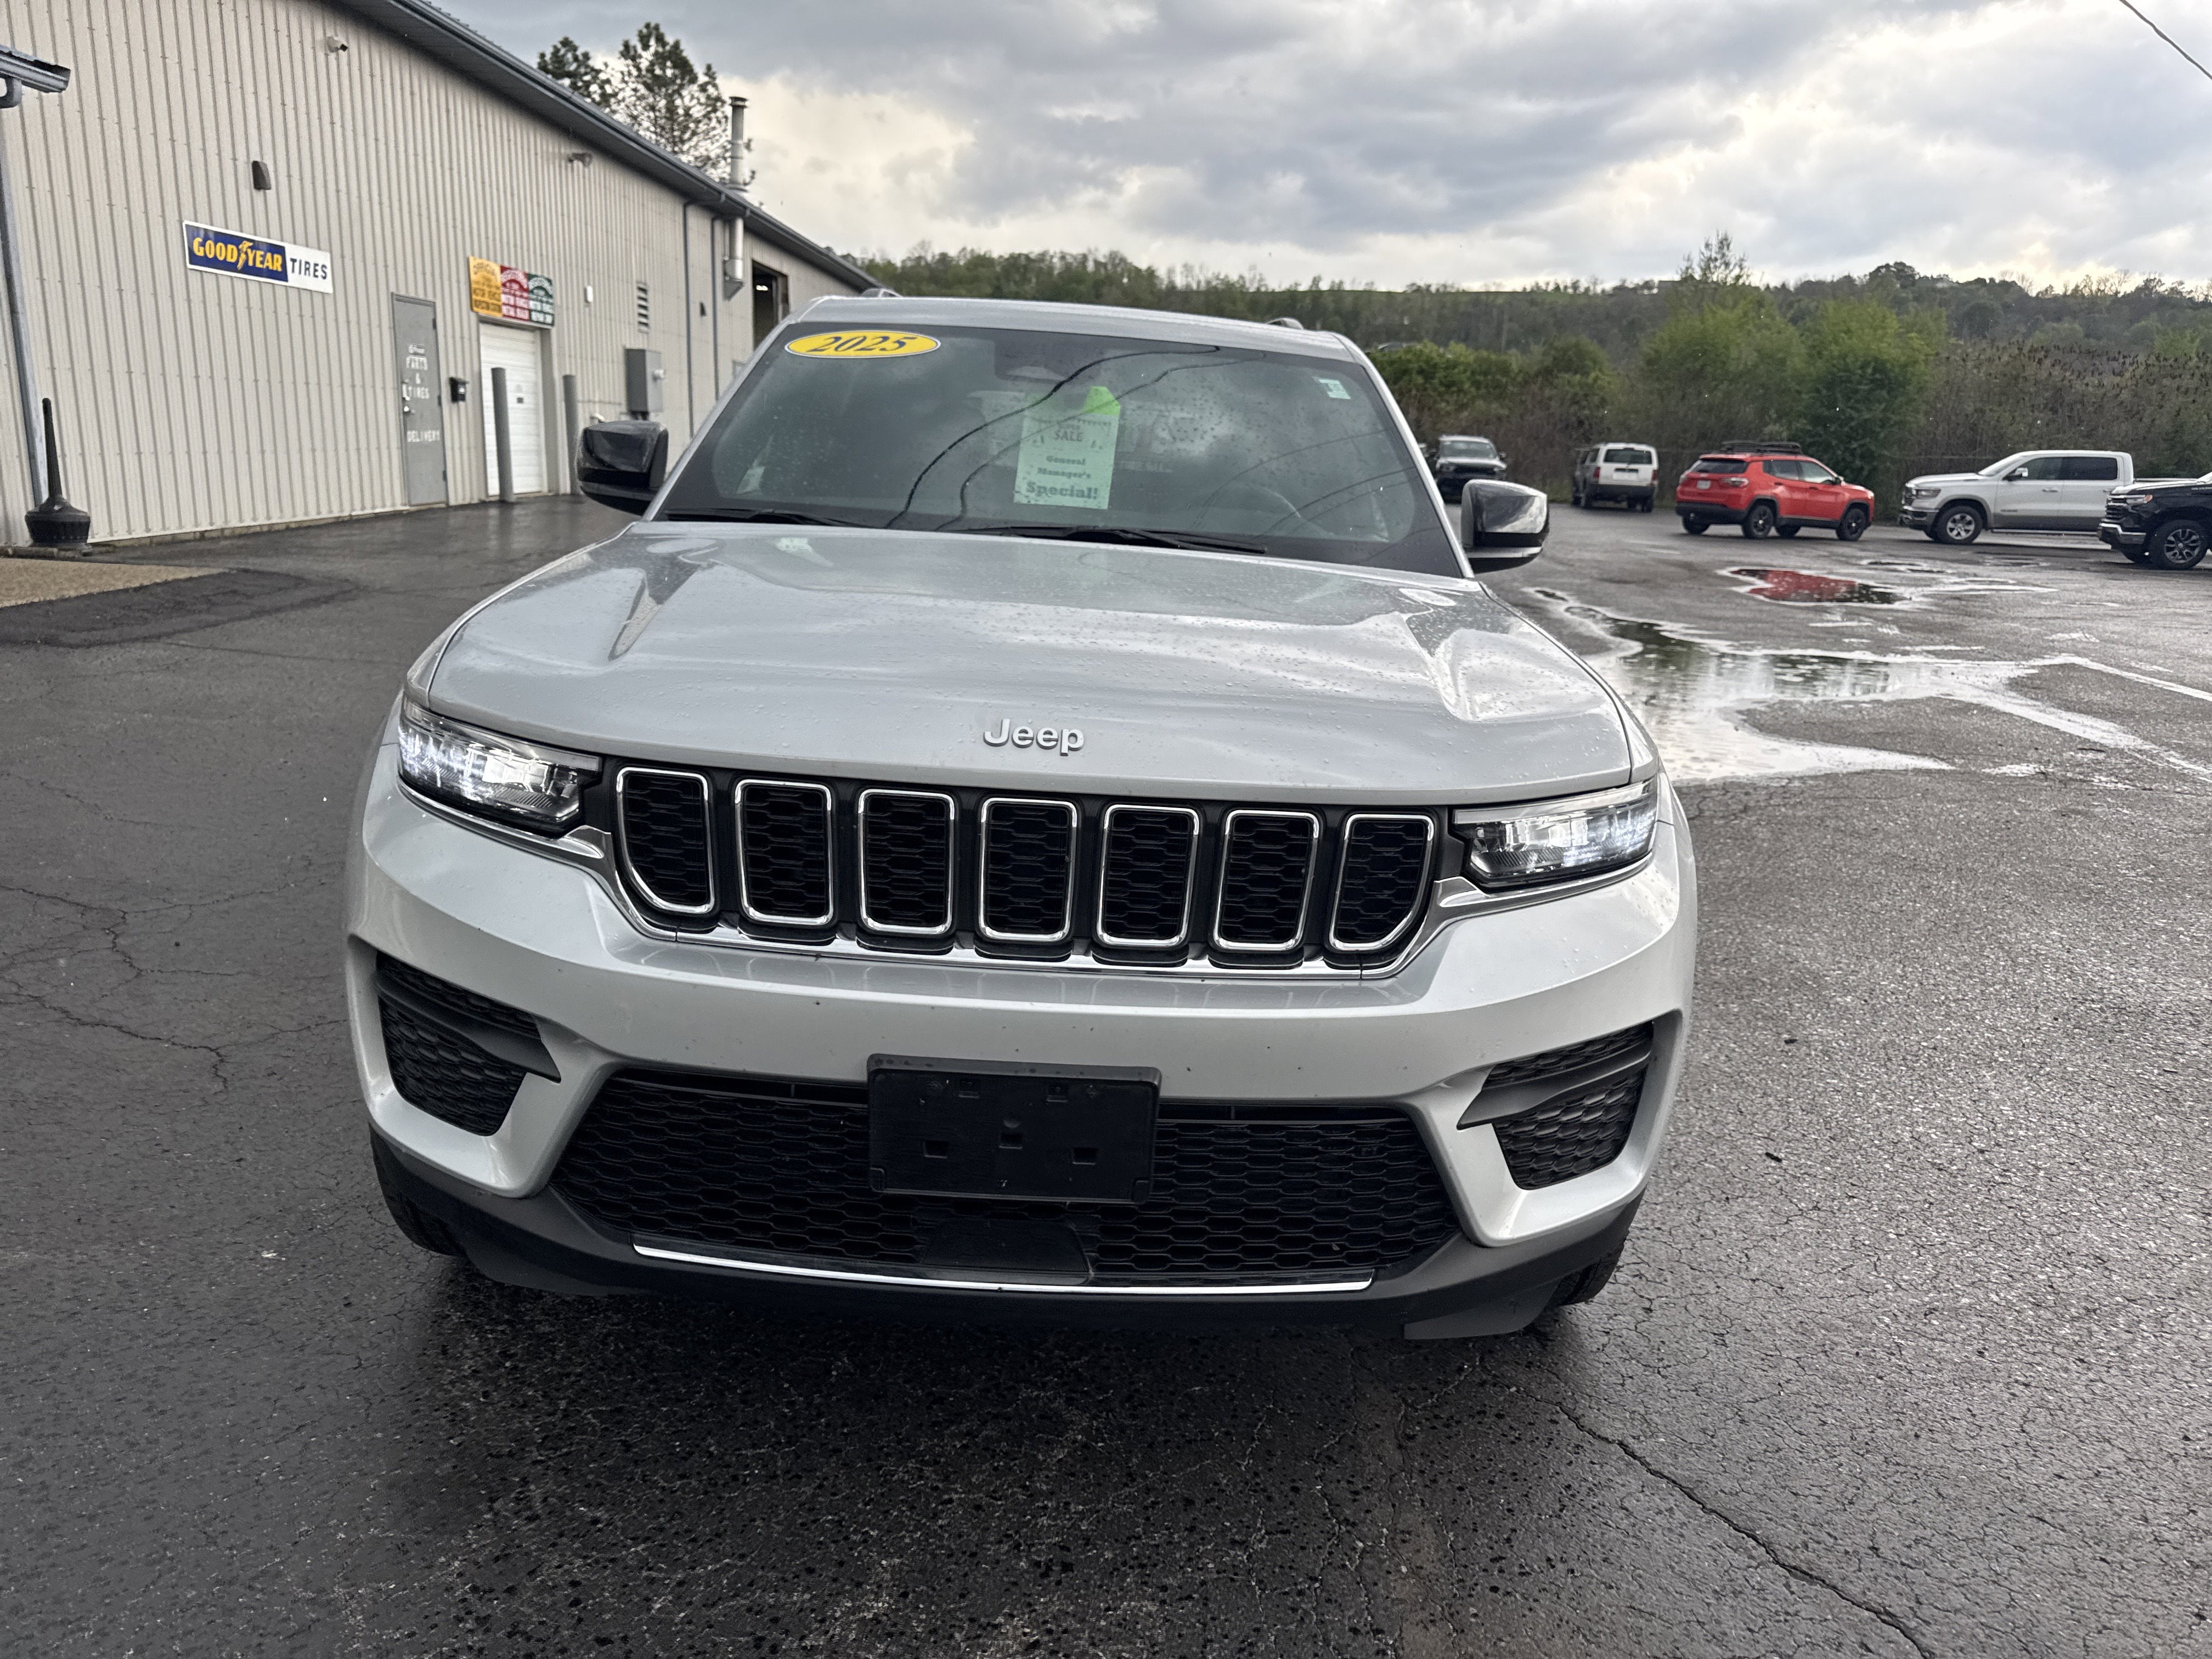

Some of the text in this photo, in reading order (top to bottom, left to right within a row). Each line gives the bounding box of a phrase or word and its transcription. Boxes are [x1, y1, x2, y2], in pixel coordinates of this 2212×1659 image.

[193, 237, 328, 280] GOODYEAR TIRES
[806, 336, 917, 352] 2025
[1054, 430, 1083, 442] SALE
[1046, 455, 1086, 465] General
[1037, 467, 1091, 479] Manager's
[1026, 482, 1098, 500] Special!
[984, 718, 1085, 757] Jeep
